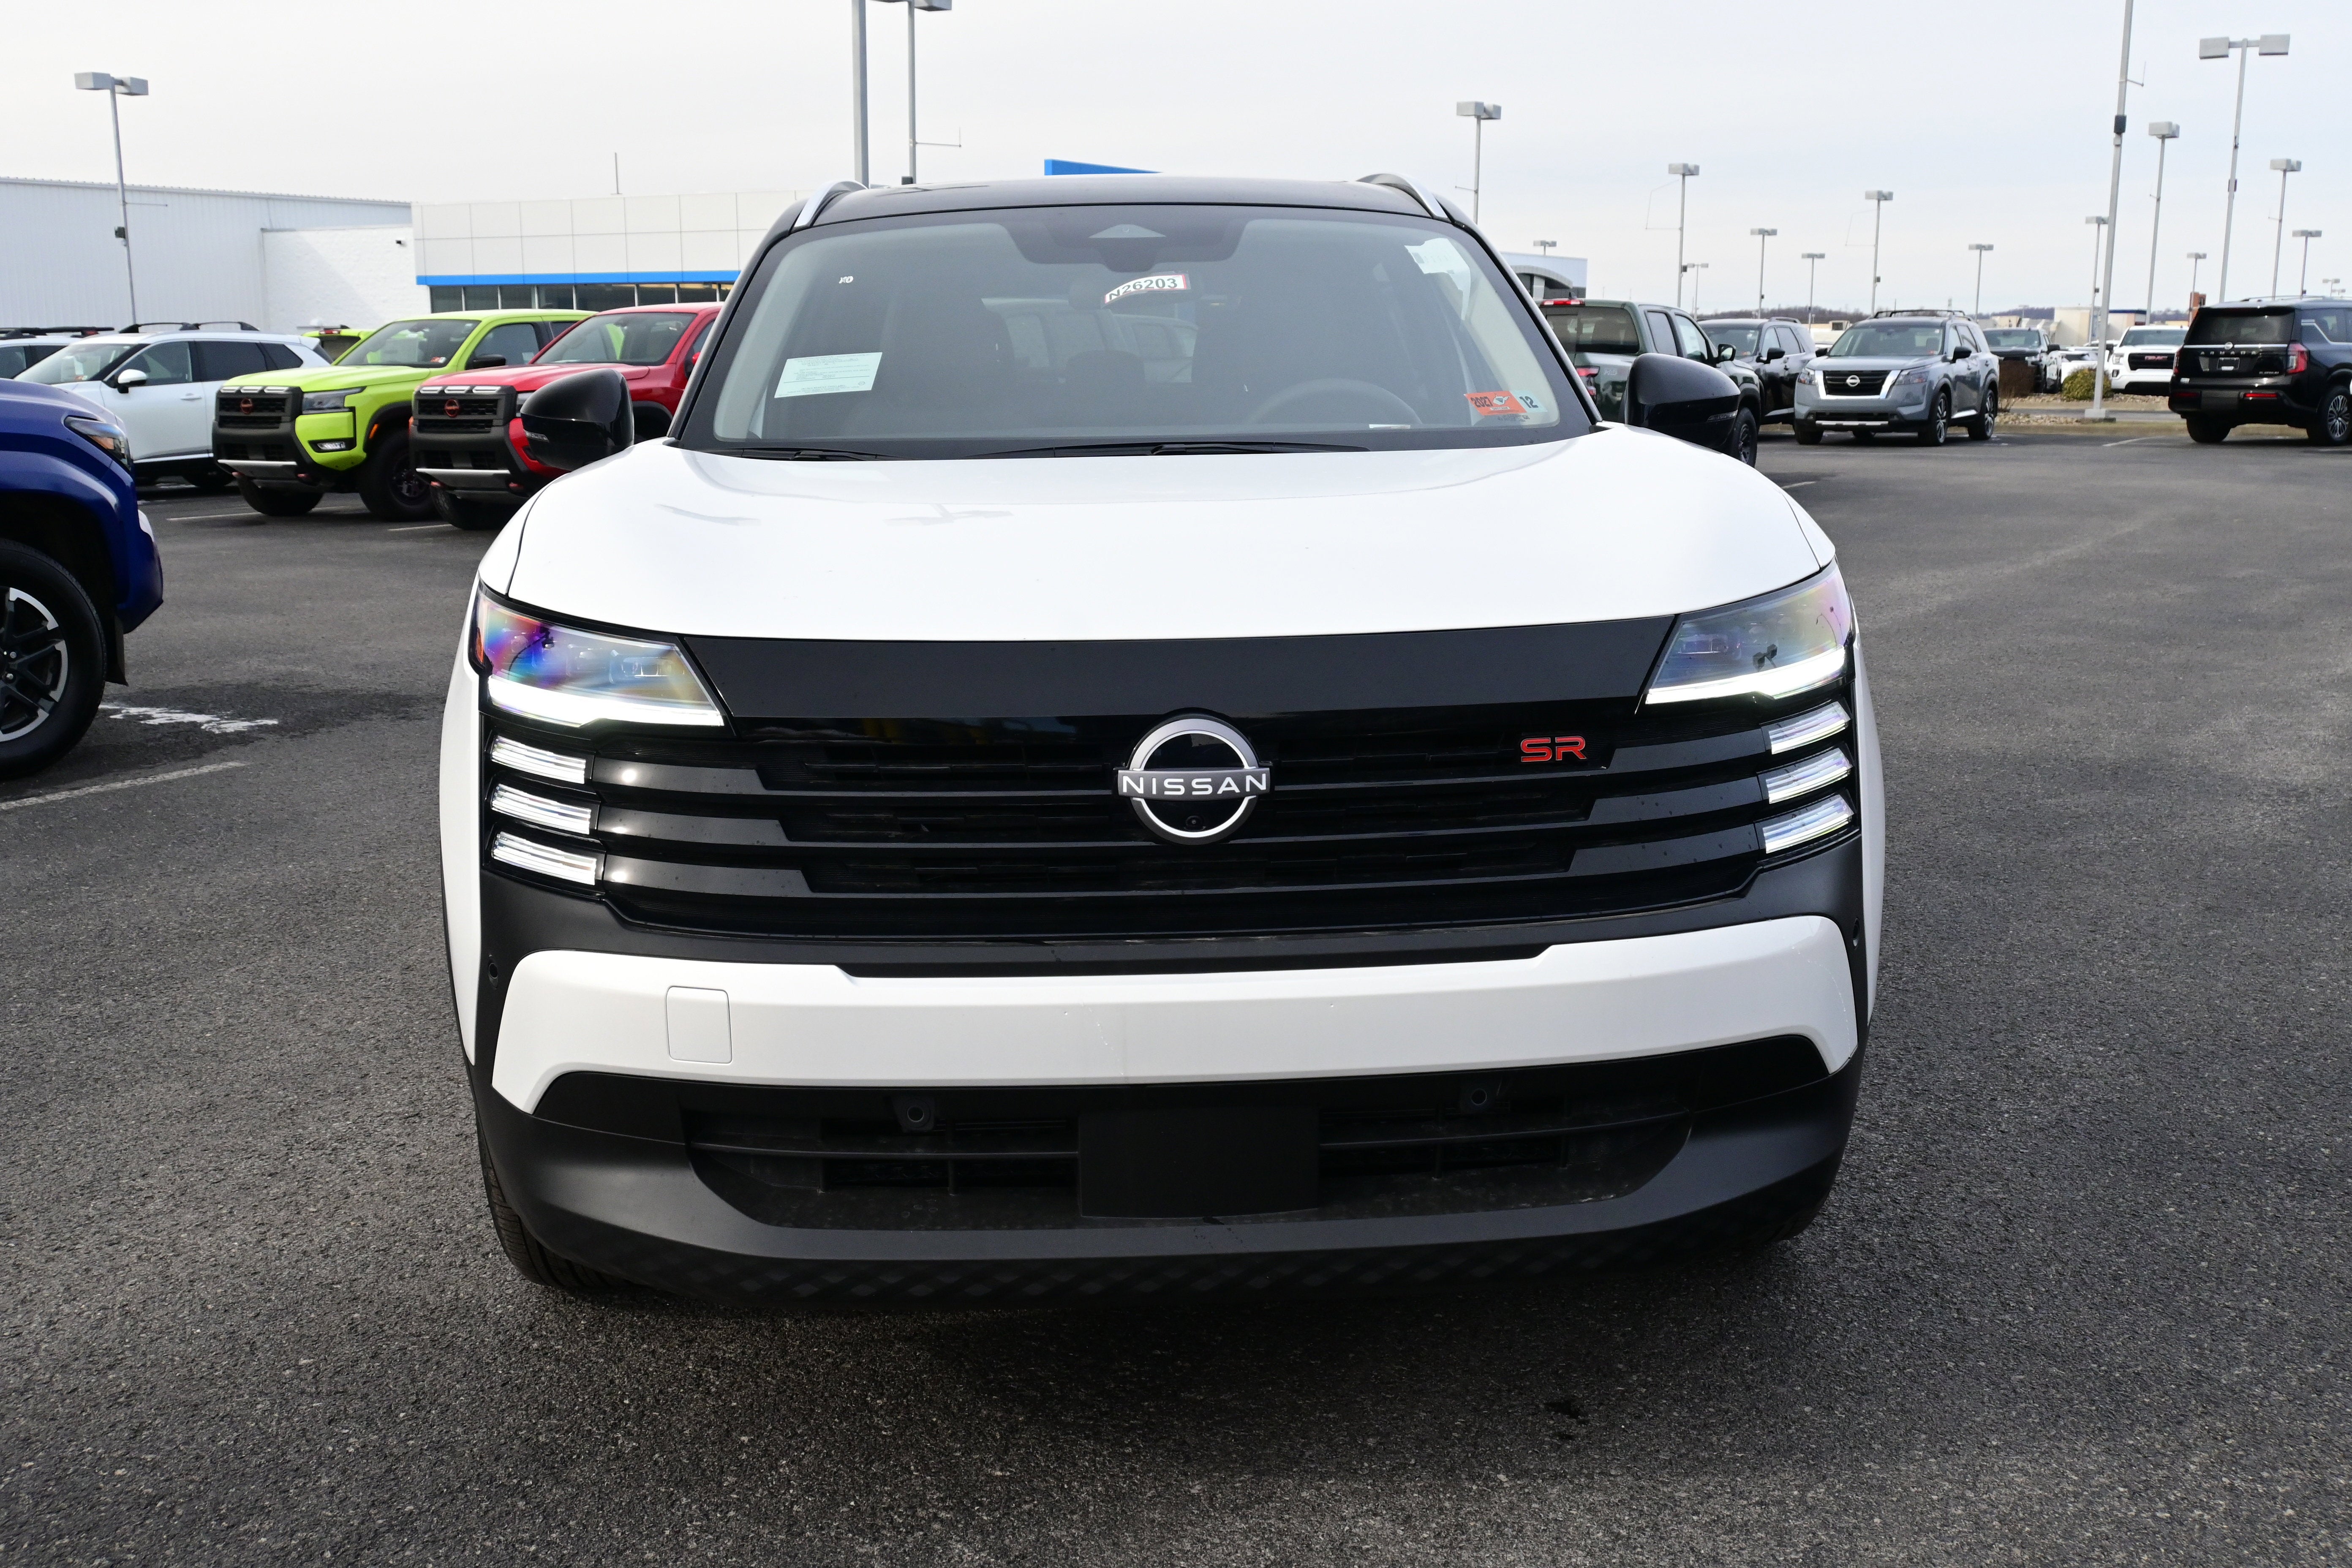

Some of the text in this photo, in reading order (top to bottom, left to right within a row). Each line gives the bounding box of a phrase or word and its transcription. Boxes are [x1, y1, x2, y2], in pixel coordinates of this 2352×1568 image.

[1109, 278, 1178, 300] N26203
[1470, 396, 1493, 408] 2027
[1519, 396, 1538, 408] 12
[1521, 735, 1587, 762] SR
[1122, 773, 1266, 795] NISSAN
